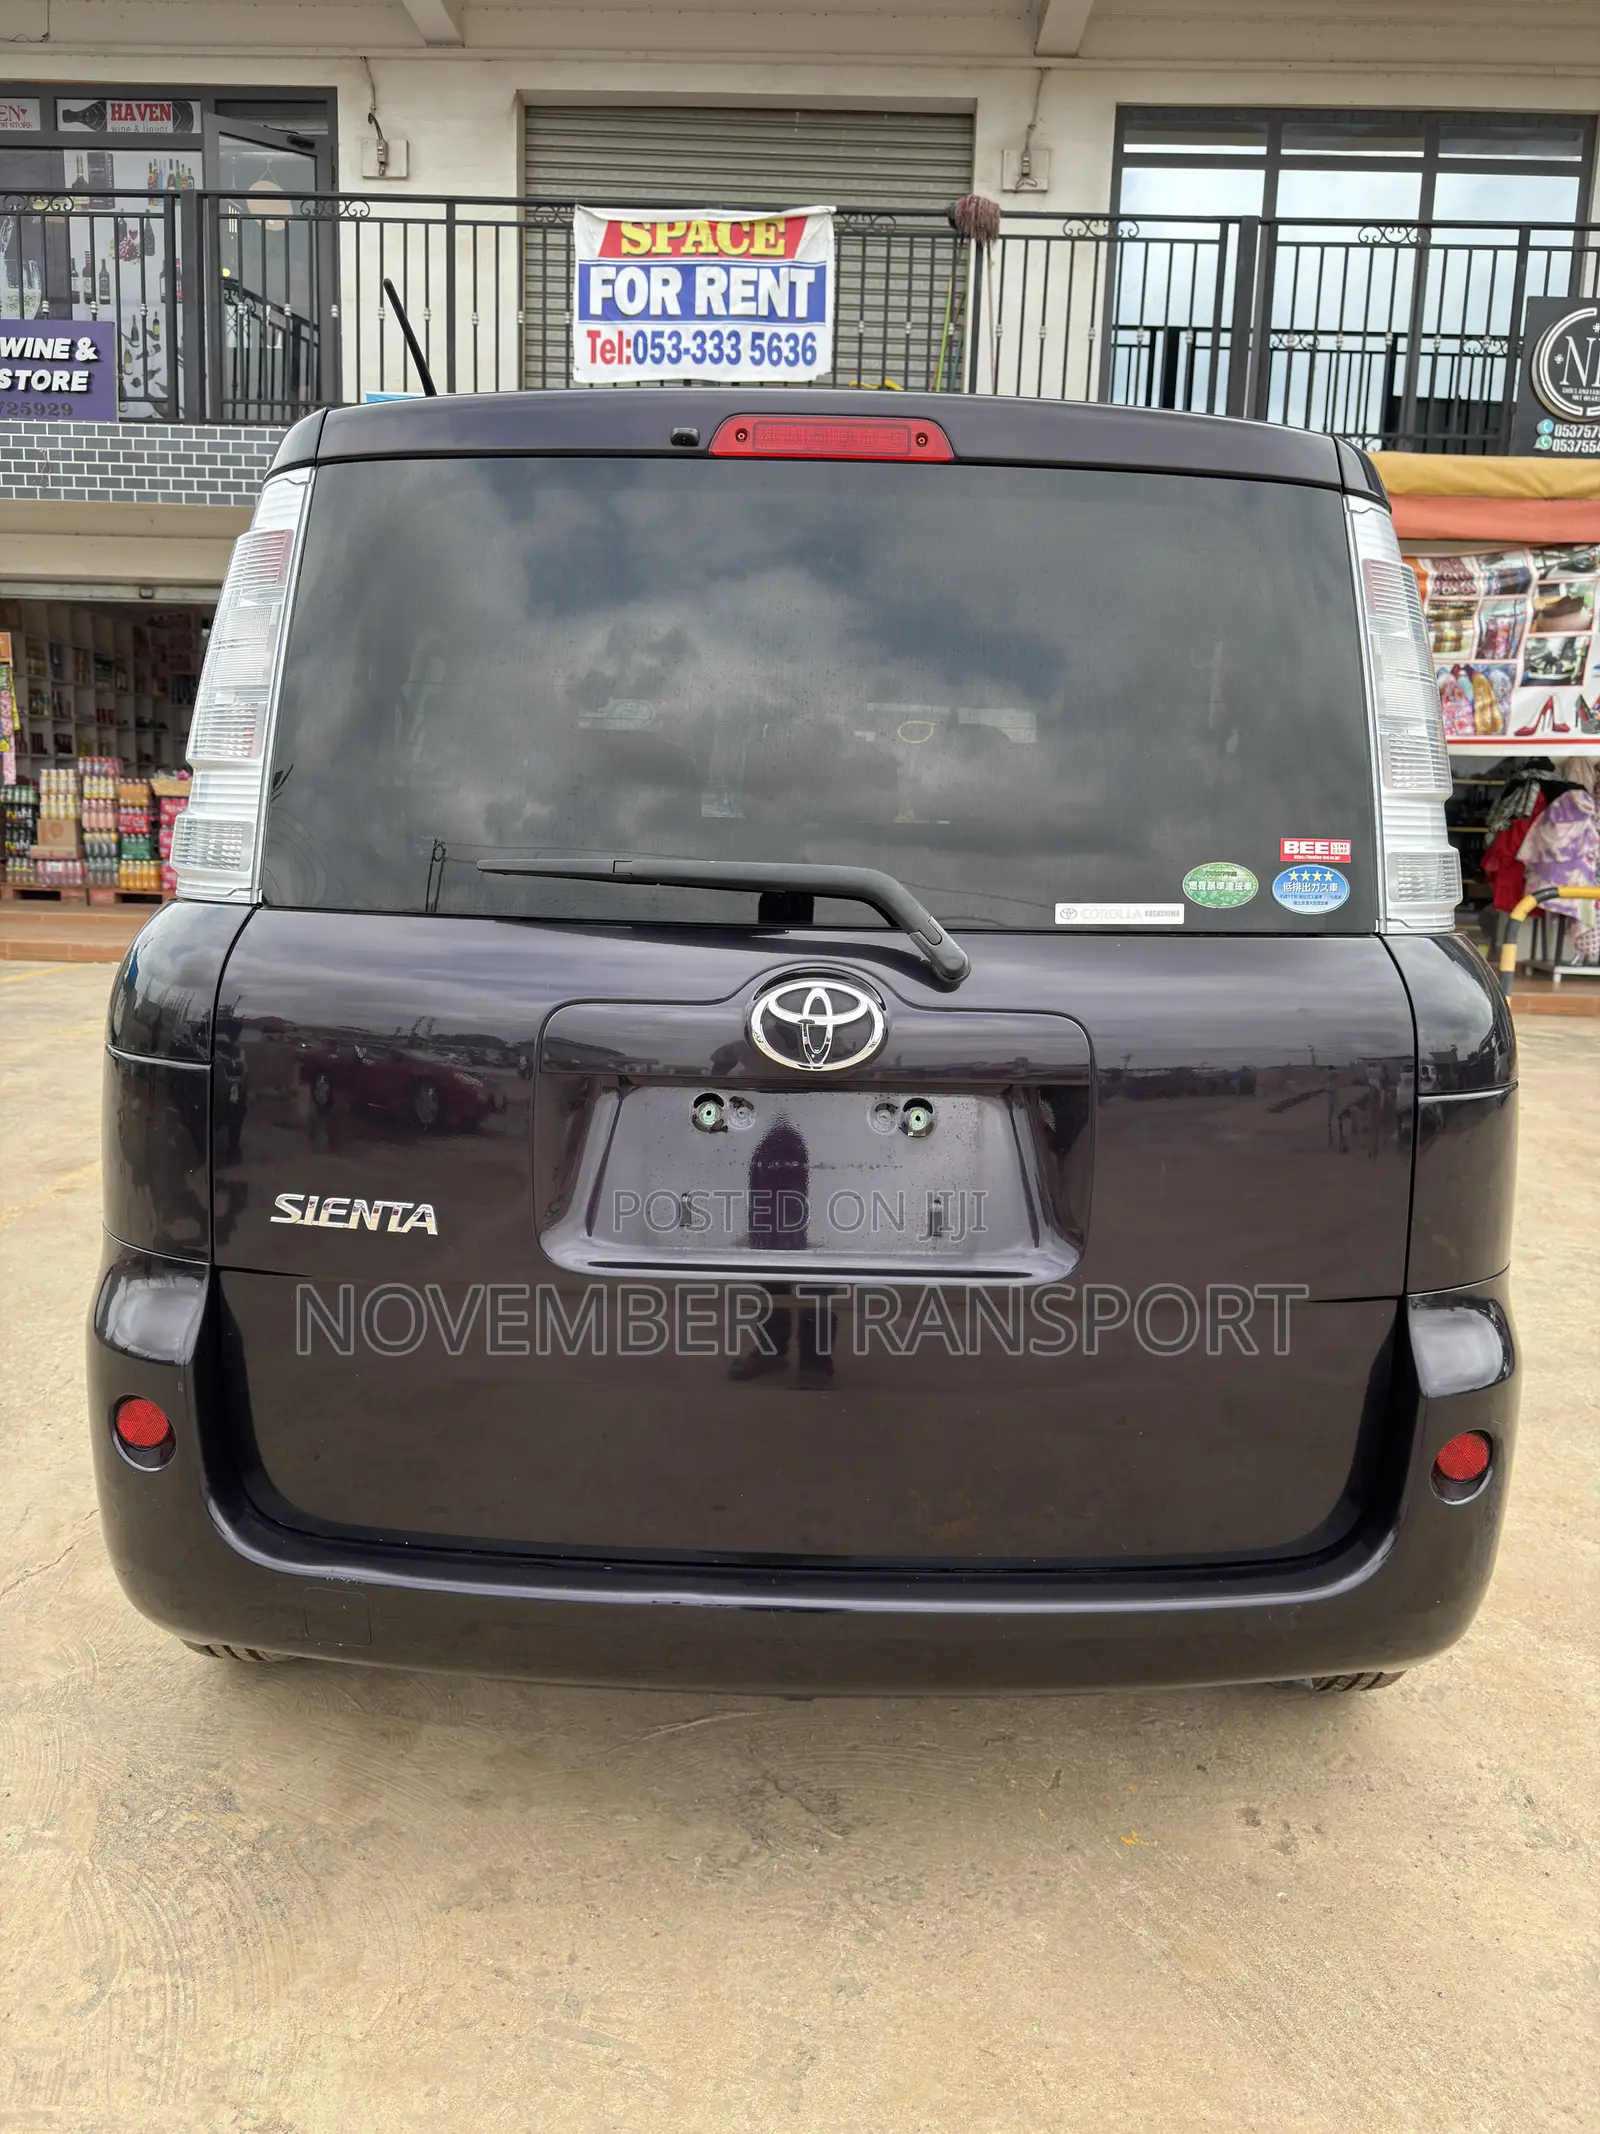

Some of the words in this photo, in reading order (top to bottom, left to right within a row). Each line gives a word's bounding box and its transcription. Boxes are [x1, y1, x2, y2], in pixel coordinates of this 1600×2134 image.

[110, 103, 171, 121] HAVEN
[9, 121, 34, 129] STORE
[620, 218, 785, 256] SPACE
[589, 266, 682, 317] FOR
[695, 266, 815, 318] RENT
[0, 336, 71, 359] WINE
[75, 337, 98, 361] &
[749, 331, 817, 367] 5636
[0, 368, 89, 392] STORE
[1554, 424, 1600, 438] 053757
[1283, 840, 1329, 854] BEE
[1282, 881, 1339, 893] 低排出ガス車
[1080, 908, 1143, 920] COROLLA
[270, 1193, 439, 1237] SIENTA
